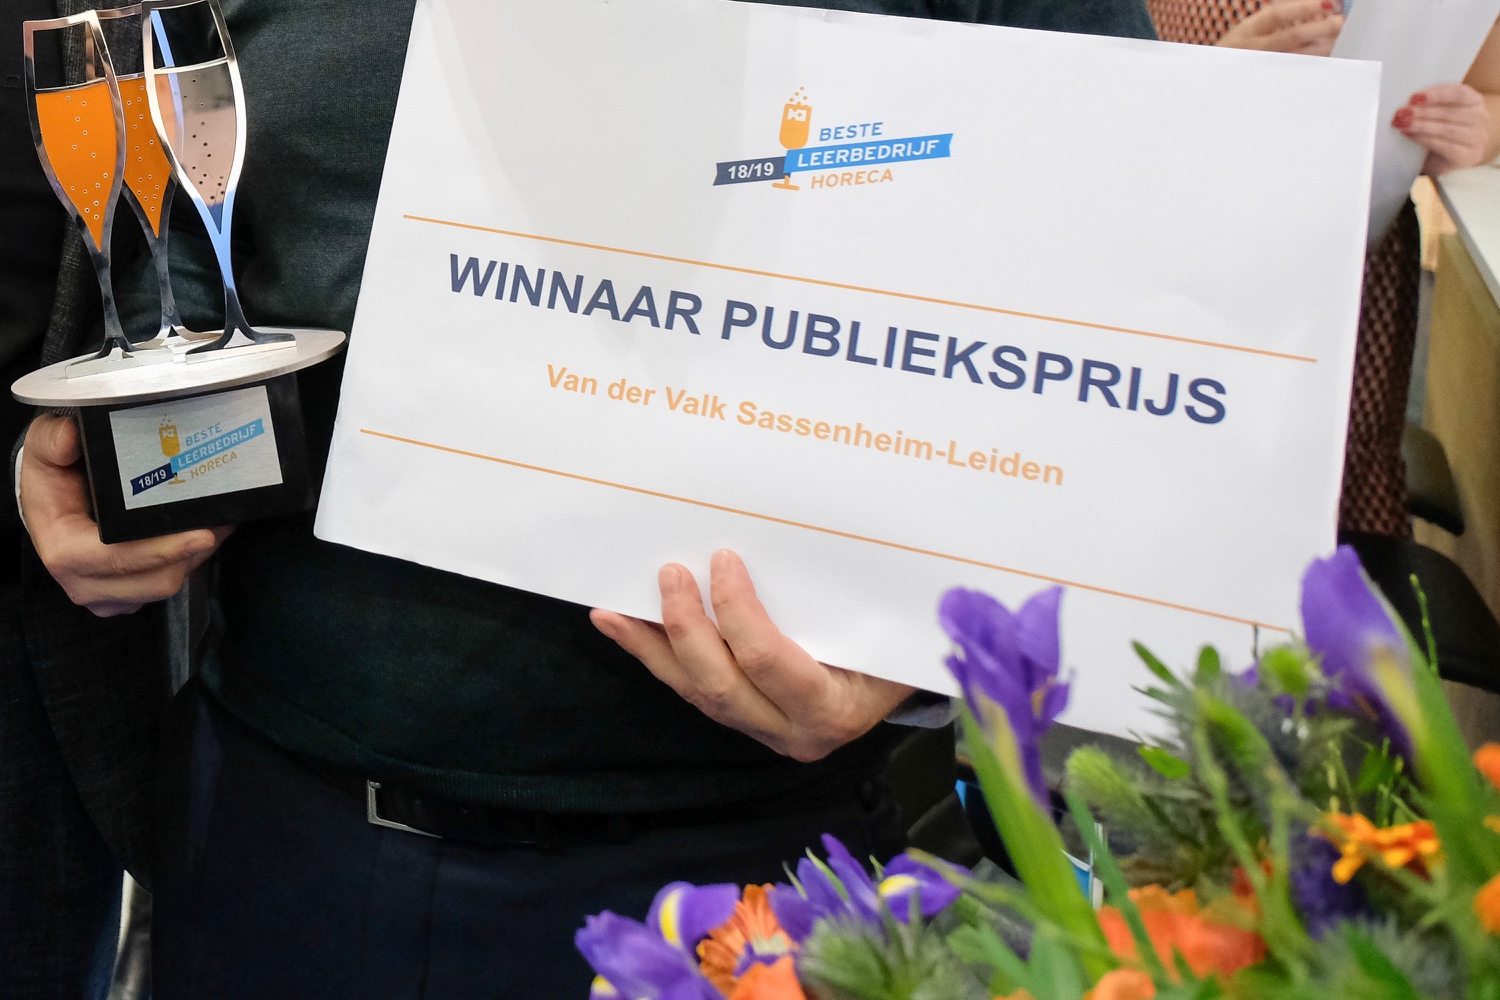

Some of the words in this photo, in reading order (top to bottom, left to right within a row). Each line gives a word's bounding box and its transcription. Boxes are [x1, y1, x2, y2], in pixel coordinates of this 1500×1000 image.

[819, 121, 884, 142] BESTE
[796, 139, 940, 168] LEERBEDRIJF
[728, 161, 775, 180] 18/19
[811, 168, 894, 190] HORECA
[449, 253, 702, 335] WINNAAR
[721, 299, 1227, 426] PUBLIEKSPRIJS
[185, 422, 223, 447] BESTE
[547, 364, 598, 396] Van
[607, 377, 656, 406] der
[665, 386, 727, 420] Valk
[736, 401, 1064, 486] Sassenheim-Leiden
[177, 424, 257, 468] LEERBEDRIJF
[190, 450, 238, 479] HORECA
[138, 469, 167, 489] 18/19
